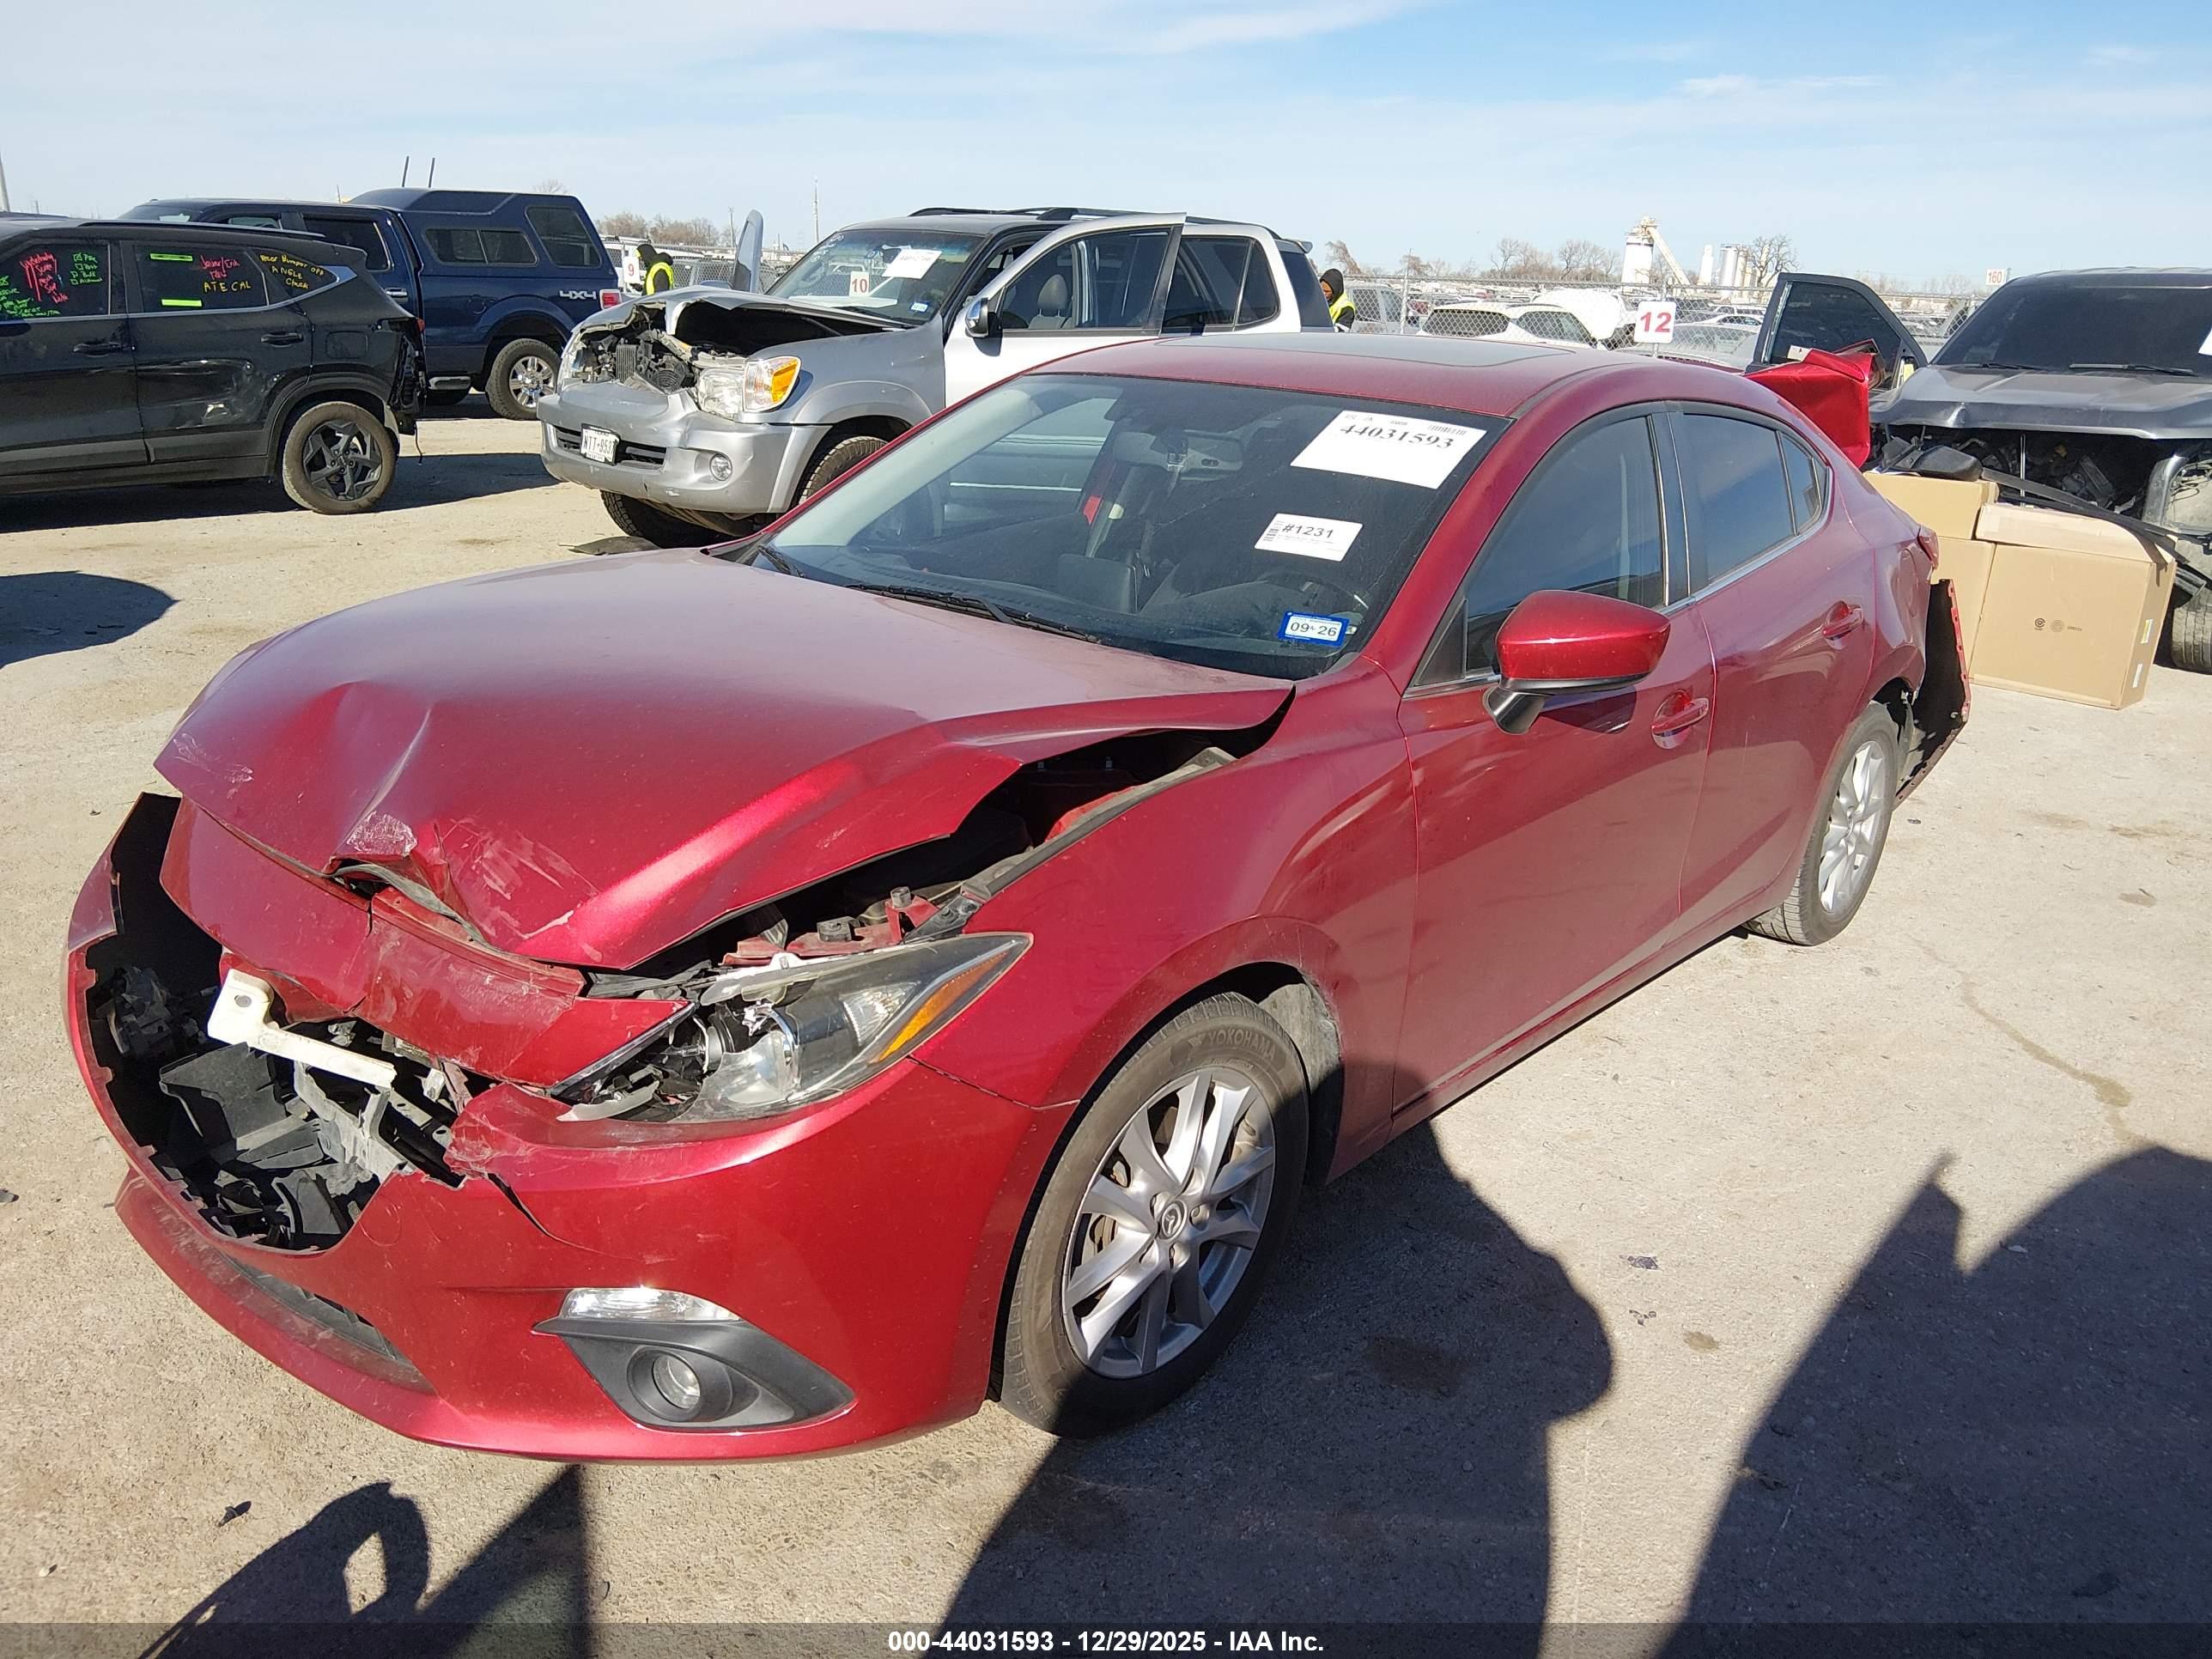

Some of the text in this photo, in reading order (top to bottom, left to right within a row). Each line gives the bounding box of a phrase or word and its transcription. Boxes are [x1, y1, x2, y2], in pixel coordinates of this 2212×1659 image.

[628, 264, 635, 276] 9
[1989, 271, 2002, 283] 160
[852, 278, 868, 293] 10
[1640, 312, 1672, 332] 12
[1340, 424, 1455, 448] 44031593
[1282, 524, 1334, 538] #1231
[1208, 1029, 1277, 1060] YOKOHAMA
